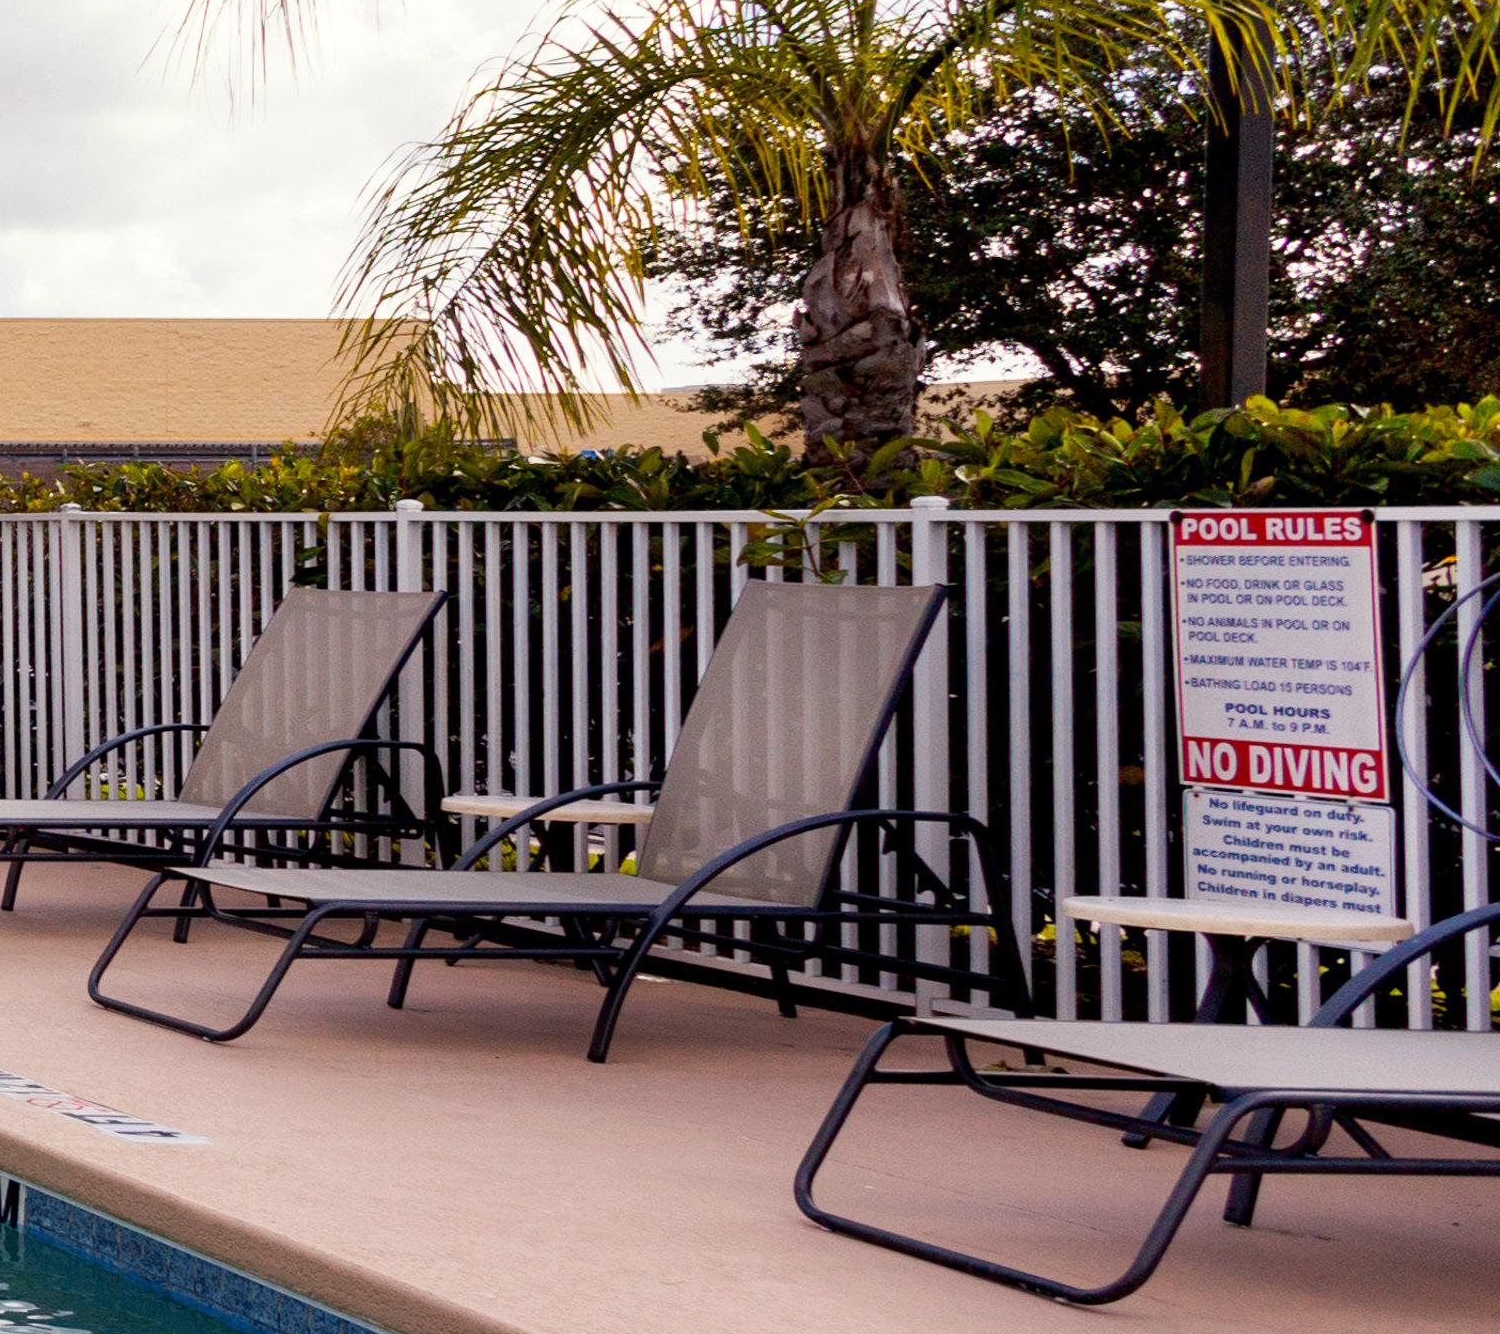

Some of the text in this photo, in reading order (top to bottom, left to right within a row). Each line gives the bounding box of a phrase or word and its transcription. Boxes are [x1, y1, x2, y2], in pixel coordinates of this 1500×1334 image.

[1181, 517, 1362, 541] POOL RULES
[1186, 556, 1350, 567] SHOWER BEFORE ENTERING.
[1186, 579, 1344, 591] NO FOOD, DRINK OR GLASS
[1188, 594, 1348, 607] IN POOL OR ON POOL DECK.
[1188, 617, 1350, 631] NO ANIMALS IN POOL OR ON
[1188, 632, 1258, 643] POOL DECK.
[1190, 654, 1244, 666] MAXIMUM
[1248, 656, 1288, 668] WATER
[1292, 658, 1322, 669] TEMP
[1326, 660, 1337, 671] IS
[1191, 678, 1353, 696] BATHING LOAD 15 PERSONS
[1225, 703, 1331, 719] POOL HOURS
[1228, 718, 1330, 734] 7 A.M. to 9 P.M.
[1187, 740, 1378, 793] NO DIVING
[1209, 798, 1364, 824] No lifeguard on duty.
[1203, 815, 1374, 842] Swim at your own risk.
[1223, 835, 1350, 858] Children must be
[1192, 847, 1386, 877] accompanied by an adult.
[1197, 864, 1381, 897] No running or horseplay.
[1198, 881, 1258, 898] Children
[1263, 889, 1276, 900] in
[1281, 892, 1337, 908] diapers
[1342, 901, 1381, 914] must
